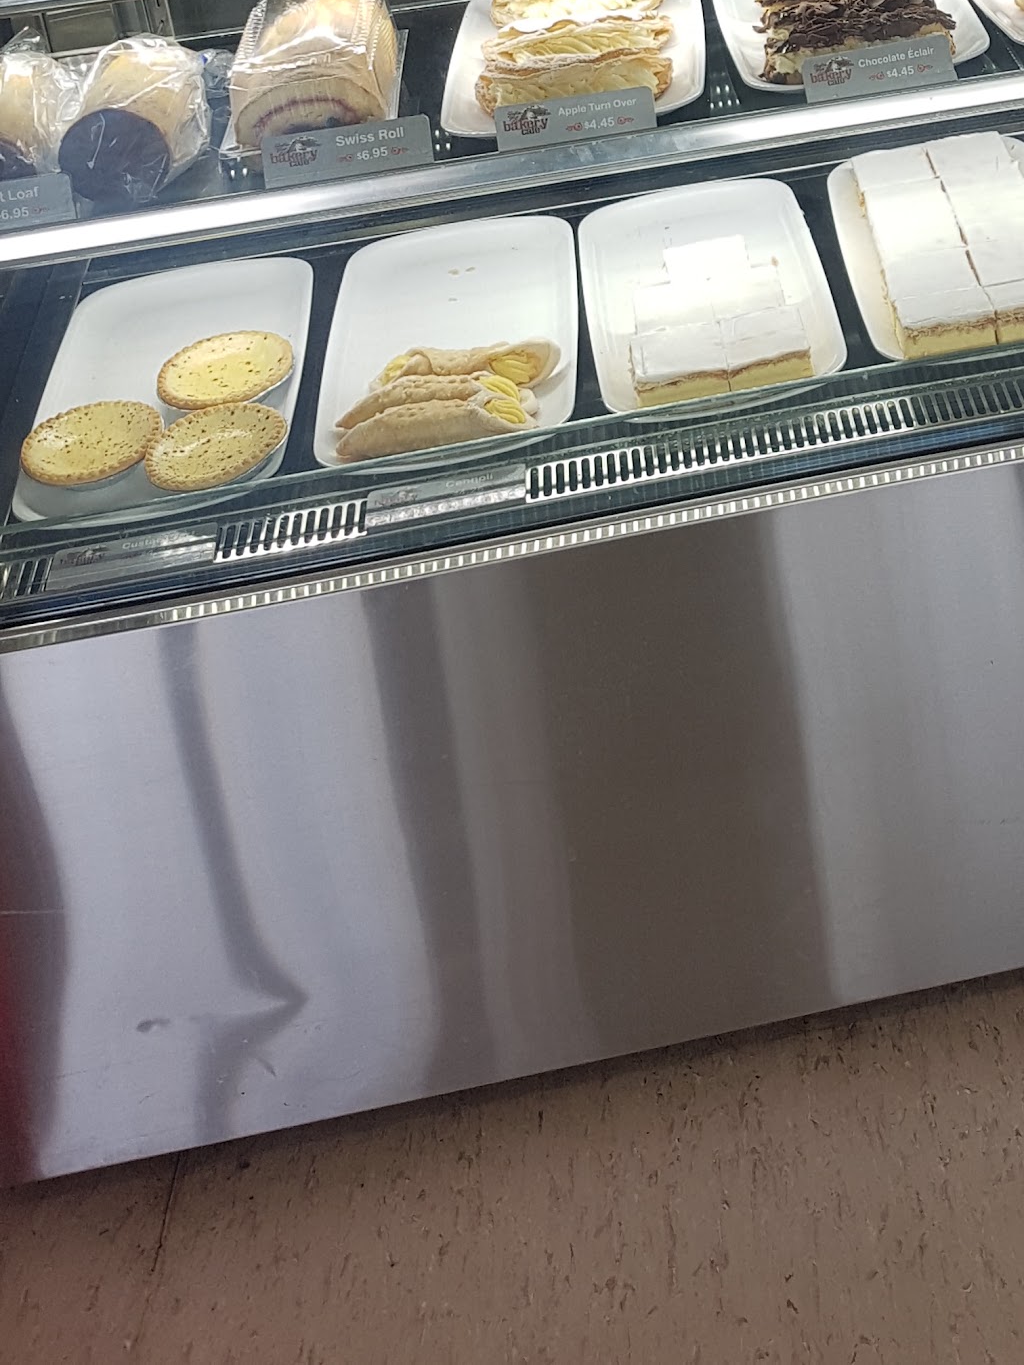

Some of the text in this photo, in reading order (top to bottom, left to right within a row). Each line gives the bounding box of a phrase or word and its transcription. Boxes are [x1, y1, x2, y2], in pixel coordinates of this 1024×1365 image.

[858, 47, 935, 68] Chocolate Éclair
[887, 66, 914, 77] $4.45
[558, 99, 637, 116] Apple Turn Over
[584, 117, 614, 129] $4.45
[336, 127, 404, 146] Swiss Roll
[357, 147, 388, 160] $6.95
[8, 186, 39, 200] Loaf
[0, 206, 29, 220] 6.95
